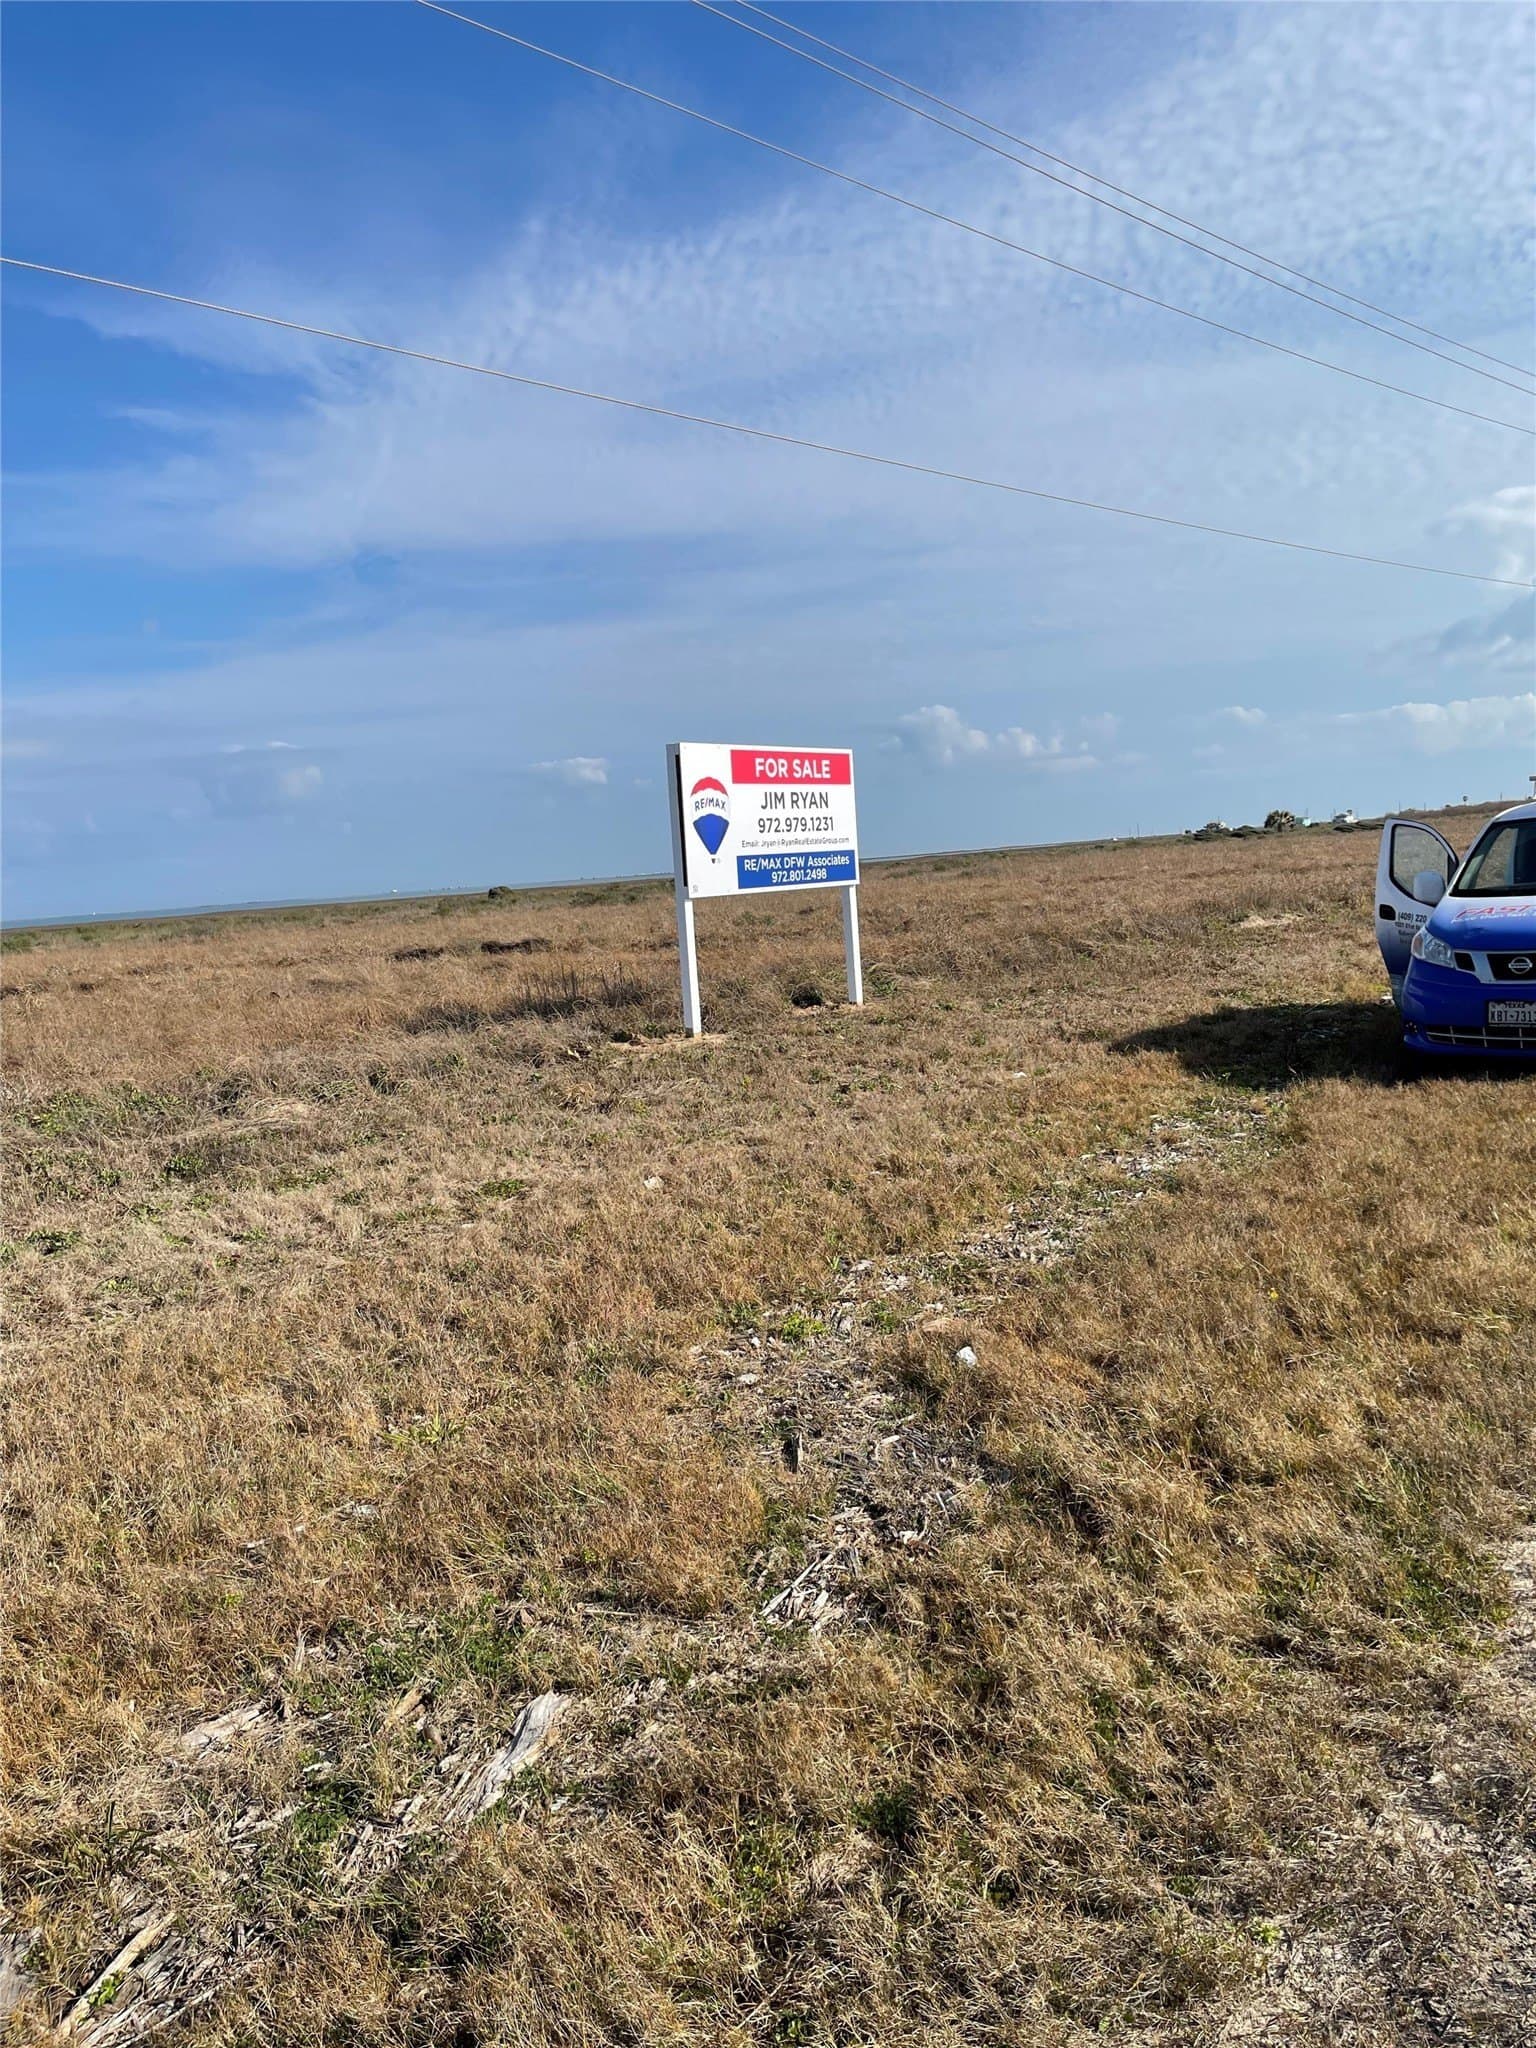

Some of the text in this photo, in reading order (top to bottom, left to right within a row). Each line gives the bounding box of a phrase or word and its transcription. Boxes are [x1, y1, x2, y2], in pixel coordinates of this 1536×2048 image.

[754, 757, 832, 779] FOR SALE
[694, 797, 727, 812] RE/MAX
[760, 791, 830, 810] JIM RYAN
[757, 816, 835, 834] 972.979.1231
[744, 854, 850, 873] RE/MAX DFW Associates
[771, 867, 828, 884] 972.801.2498
